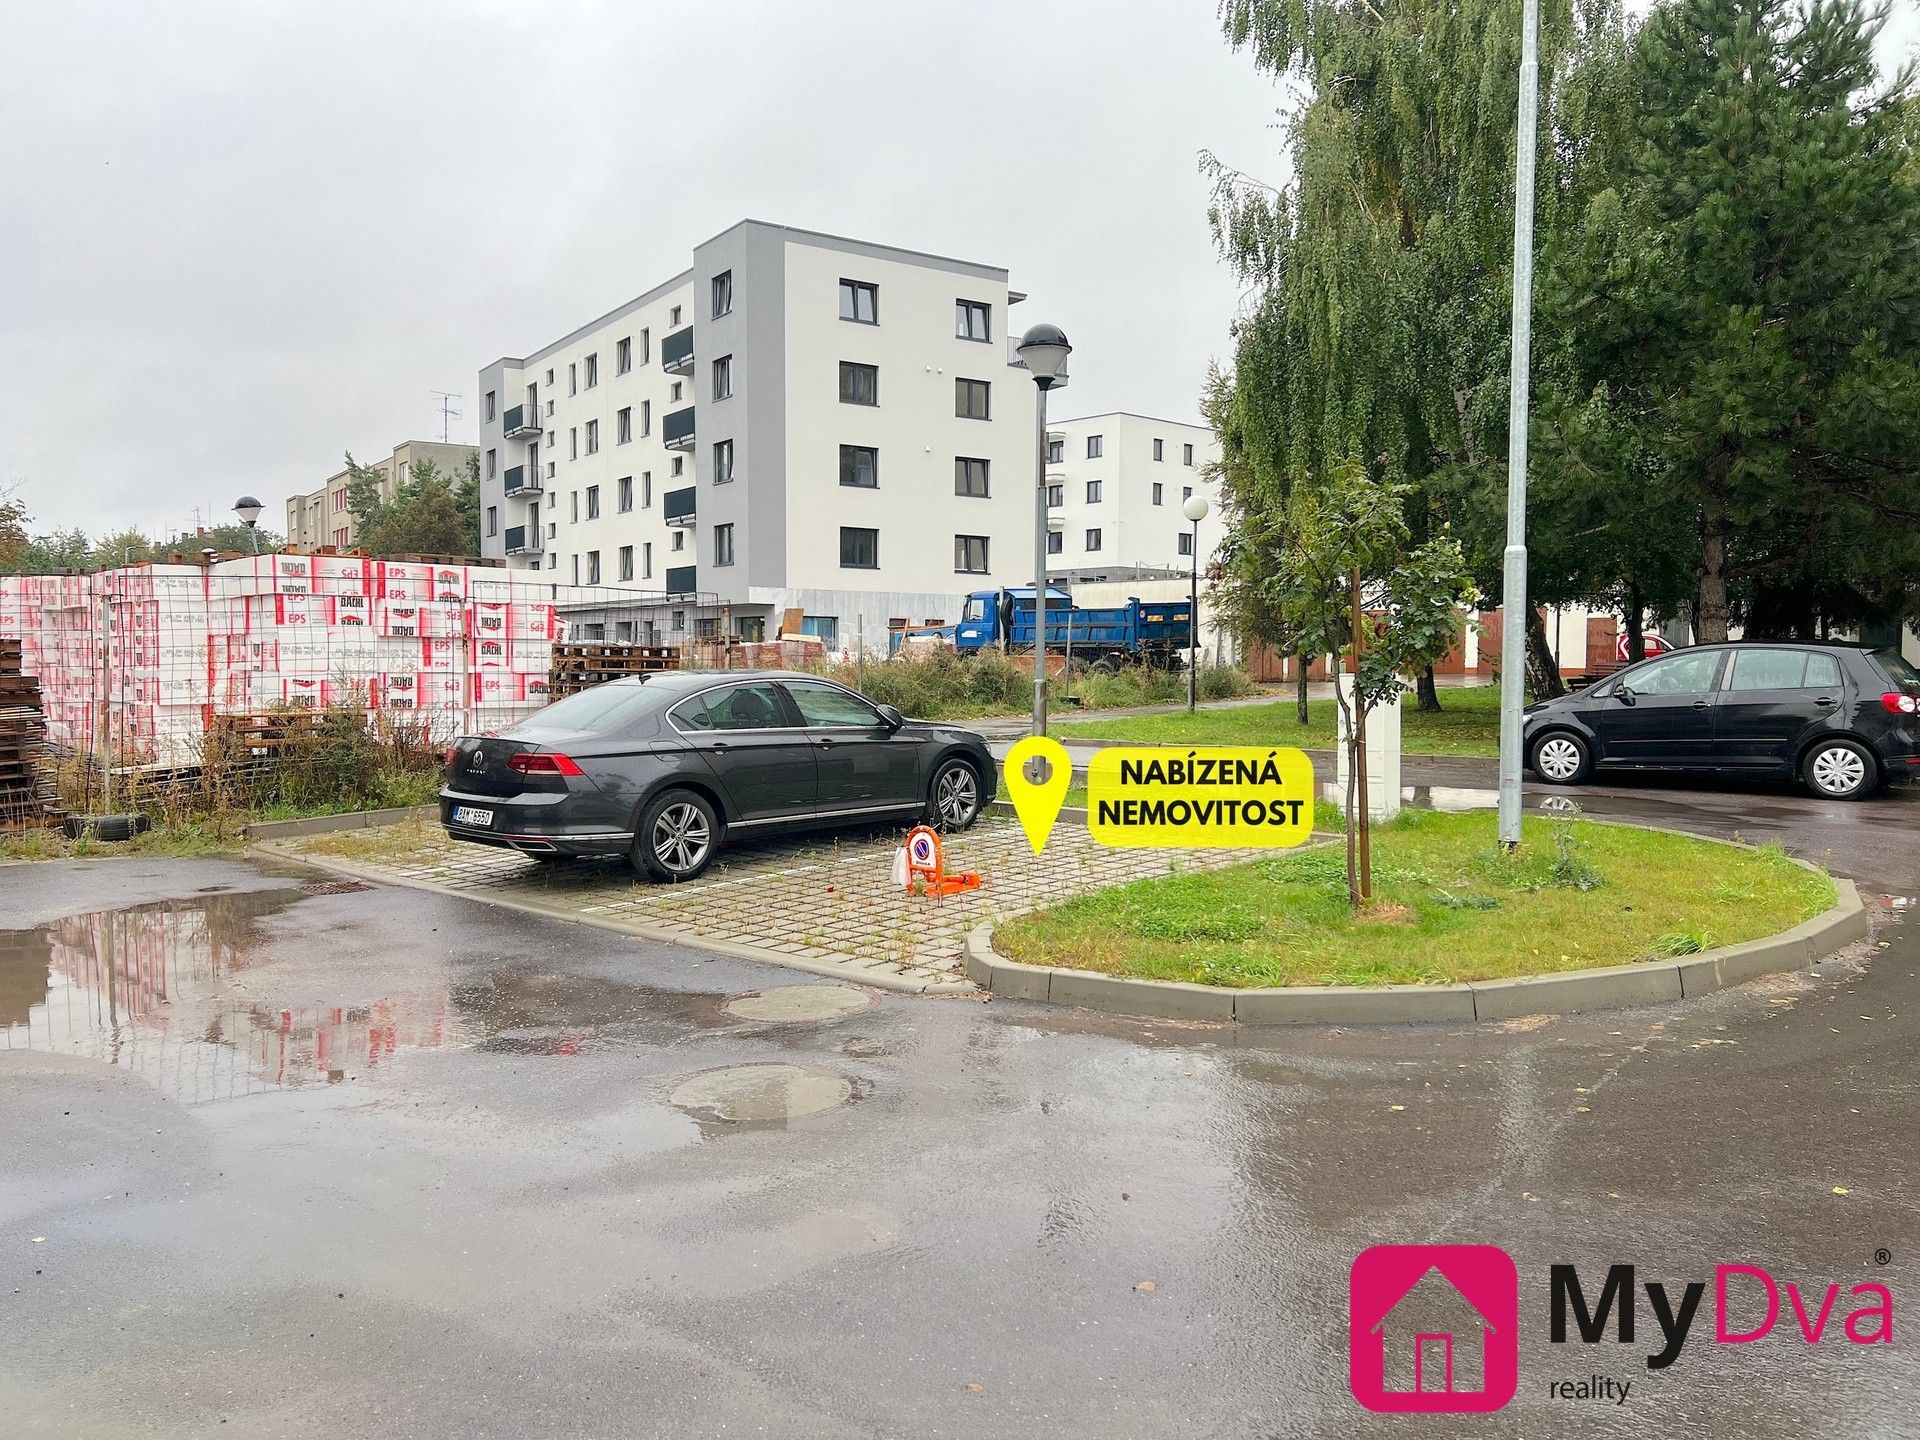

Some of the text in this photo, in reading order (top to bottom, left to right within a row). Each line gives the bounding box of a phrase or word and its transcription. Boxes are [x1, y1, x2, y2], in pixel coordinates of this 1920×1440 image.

[341, 568, 358, 578] EPS
[389, 568, 406, 577] EPS
[389, 590, 406, 600] EPS
[288, 614, 306, 624] EPS
[530, 623, 545, 632] EPS
[434, 641, 450, 650] EPS
[444, 681, 460, 691] EPS
[485, 681, 500, 690] EPS
[473, 810, 490, 823] 6550
